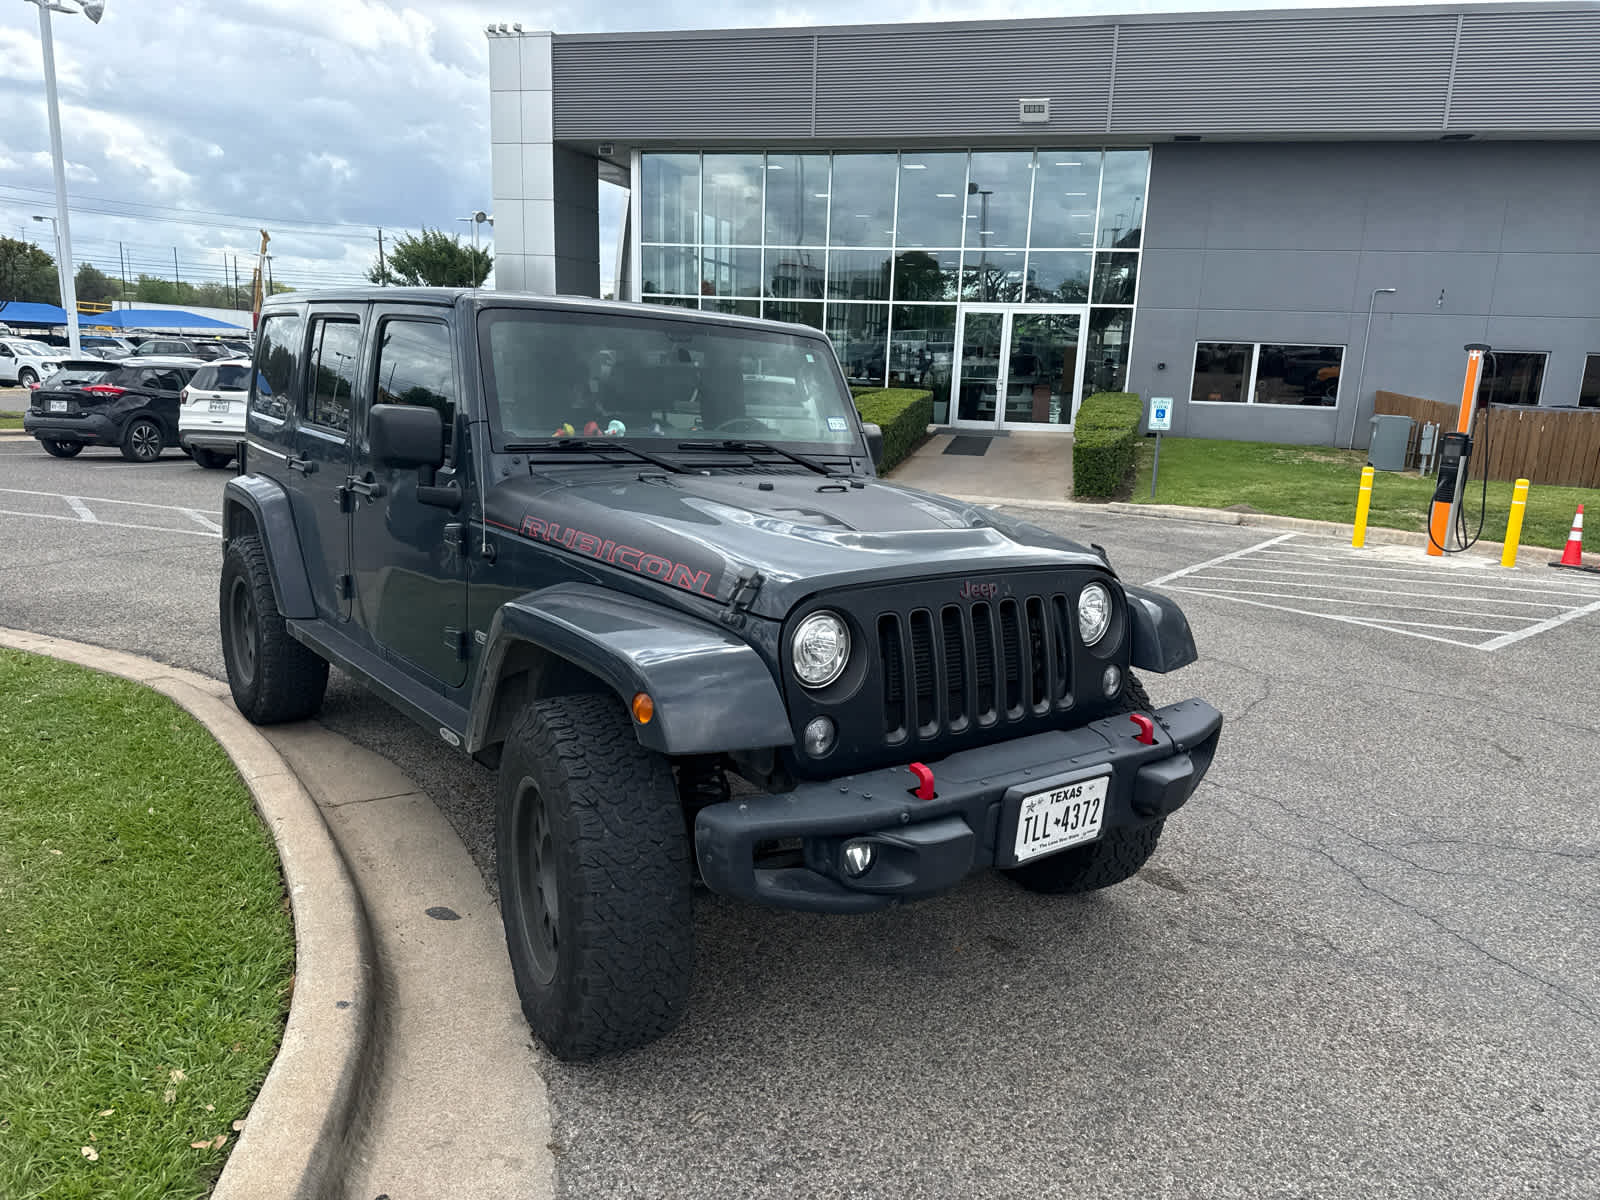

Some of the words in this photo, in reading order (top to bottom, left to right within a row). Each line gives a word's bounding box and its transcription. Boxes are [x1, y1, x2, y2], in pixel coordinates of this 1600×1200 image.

[519, 515, 716, 598] RUBICON
[960, 580, 998, 600] Jeep
[1050, 786, 1082, 804] TEXAS
[1024, 812, 1051, 844] TLL
[1061, 798, 1100, 832] 4372
